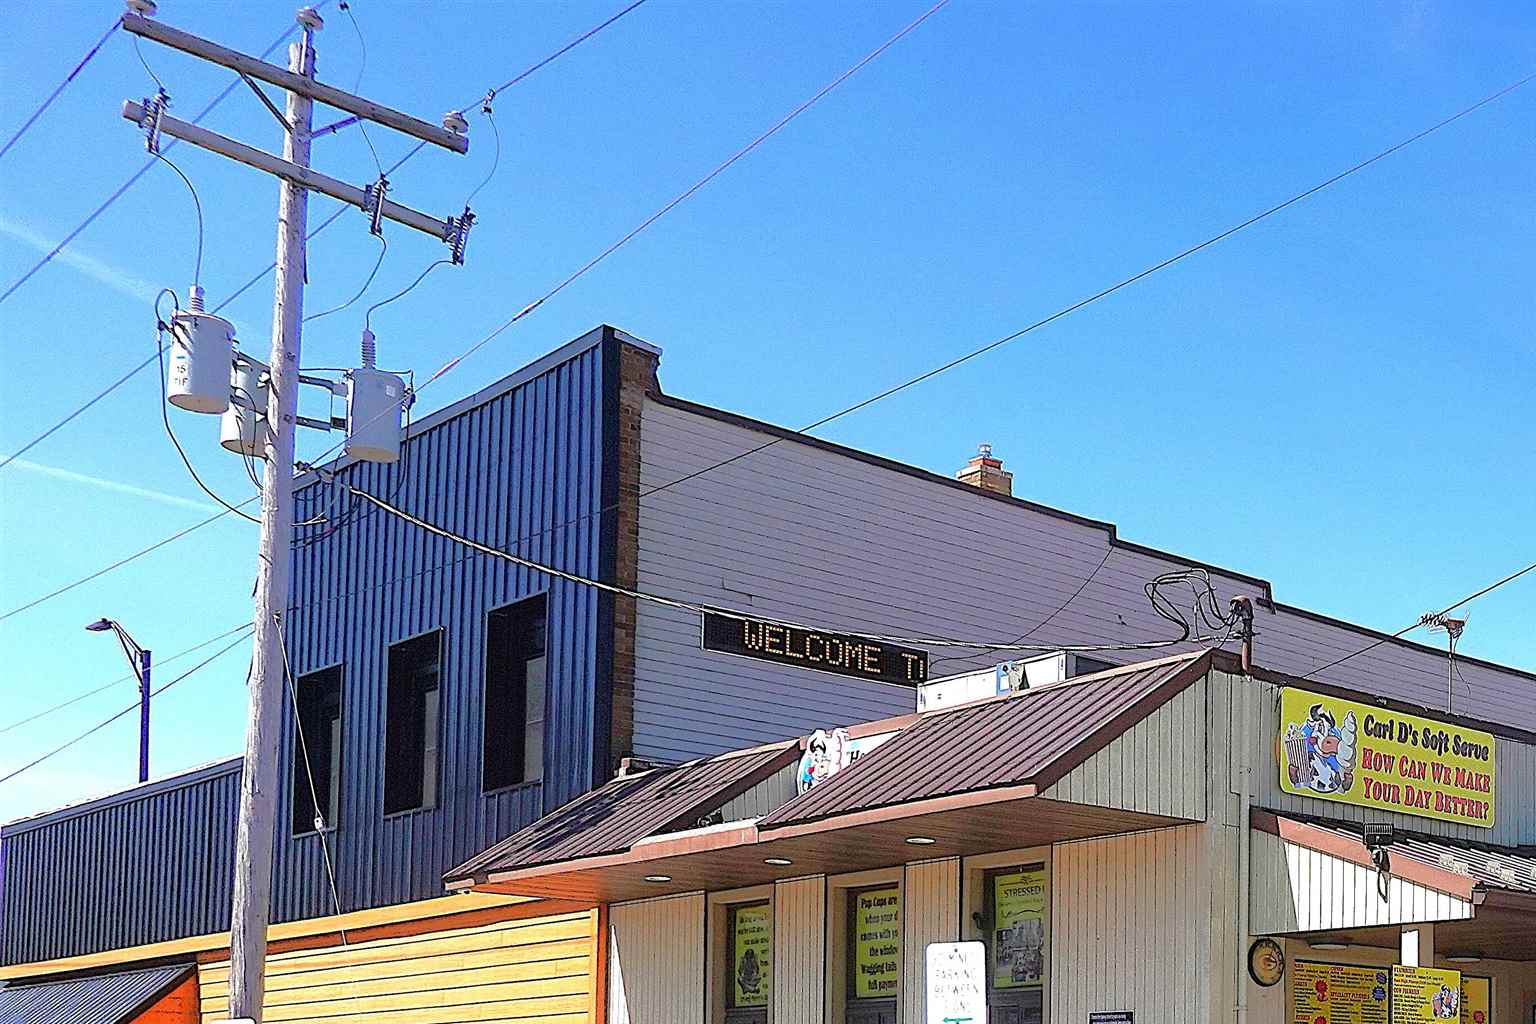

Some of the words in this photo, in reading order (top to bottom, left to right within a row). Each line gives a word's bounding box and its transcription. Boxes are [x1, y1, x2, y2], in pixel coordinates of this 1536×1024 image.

[744, 620, 881, 674] WELCOME
[1363, 714, 1394, 739] Carl
[1397, 721, 1418, 747] D's
[1422, 728, 1449, 757] Soft
[1452, 735, 1490, 762] Serve
[1361, 747, 1395, 774] HOW
[1399, 755, 1427, 781] CAN
[1431, 762, 1452, 785] WE
[1455, 766, 1491, 793] MAKE
[1363, 777, 1401, 805] YOUR
[1404, 785, 1433, 812] DAY
[1434, 791, 1490, 820] BETTER?
[1004, 885, 1041, 898] STRESSED
